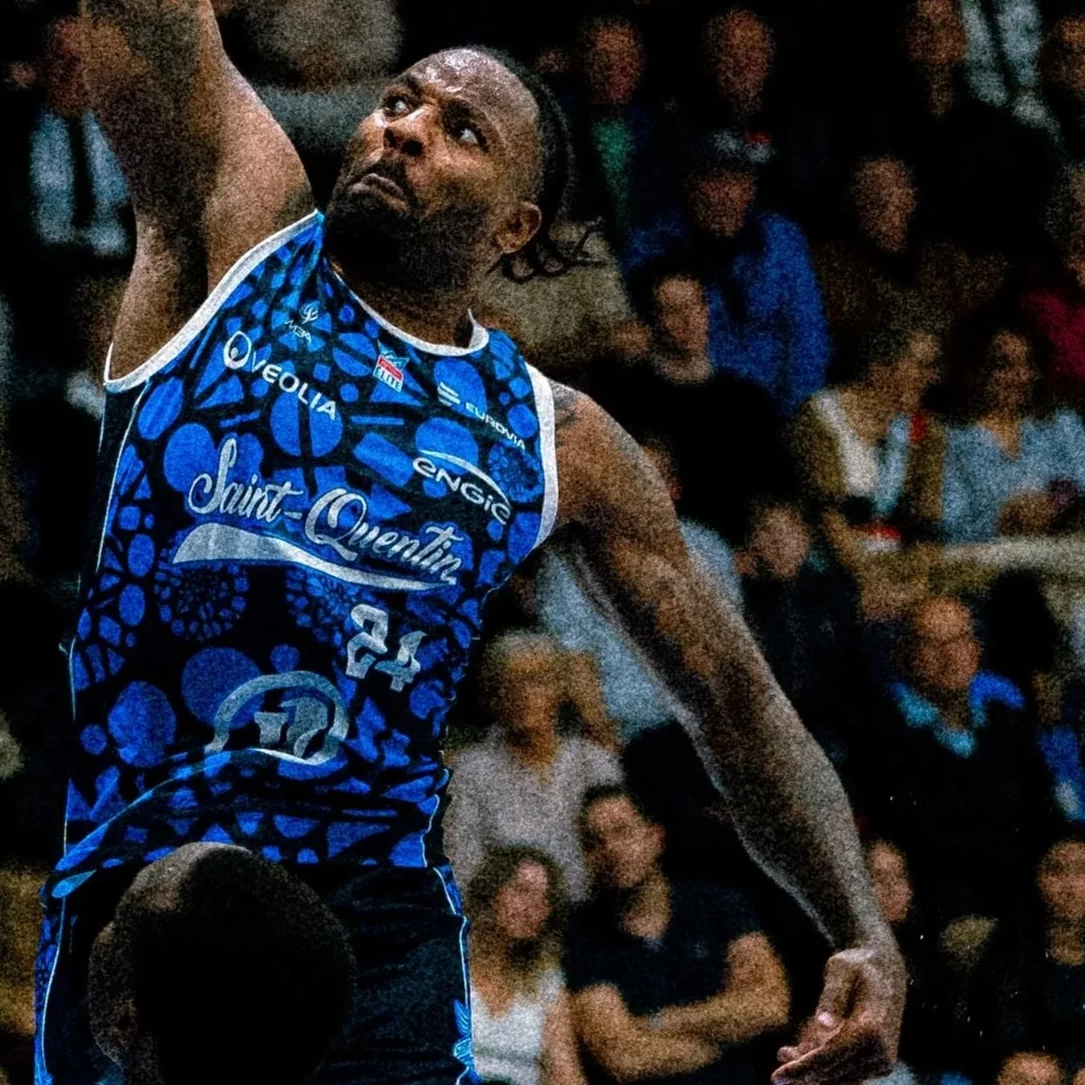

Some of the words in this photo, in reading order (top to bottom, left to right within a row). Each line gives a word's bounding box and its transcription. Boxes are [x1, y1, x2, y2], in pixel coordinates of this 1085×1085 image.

[251, 351, 338, 421] VEOLIA
[465, 401, 526, 450] EUROVIA
[187, 437, 465, 586] Saint-Quentin
[345, 603, 427, 693] 24
